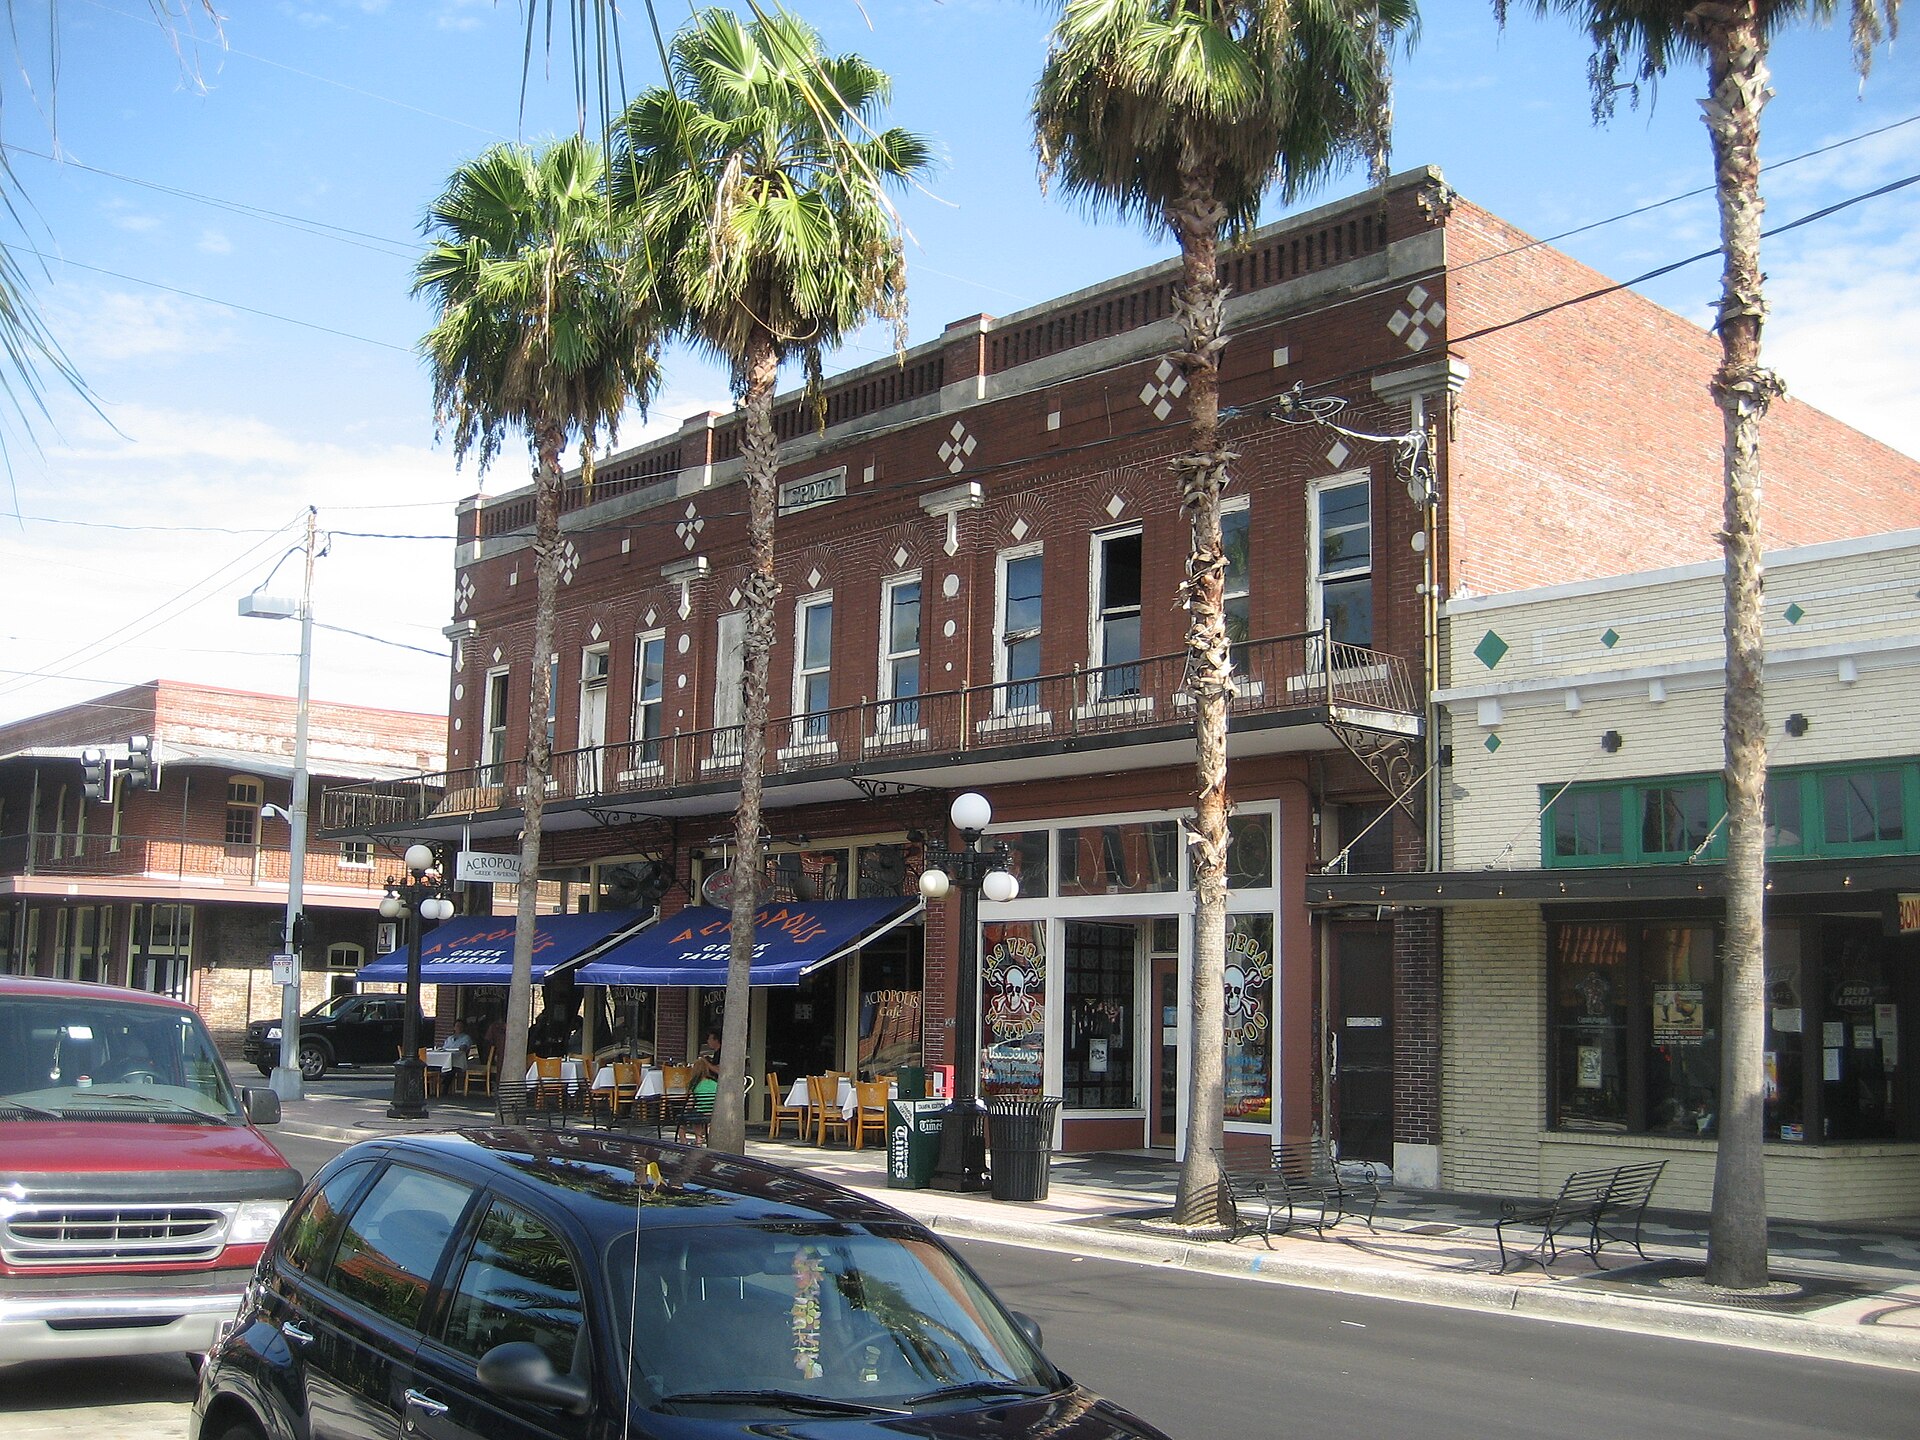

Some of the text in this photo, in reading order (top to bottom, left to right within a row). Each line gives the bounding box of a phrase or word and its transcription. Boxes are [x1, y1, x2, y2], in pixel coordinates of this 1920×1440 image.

[790, 479, 836, 504] SPOTO
[1067, 823, 1269, 882] TATTO
[465, 857, 521, 873] ACROPOLI
[474, 869, 517, 878] GREEK TAVERNA
[1899, 900, 1920, 929] BON
[450, 949, 507, 957] GREEK
[702, 943, 772, 952] GRK
[678, 952, 765, 961] TAVEA
[982, 937, 1046, 981] LAS VEGAS
[285, 966, 290, 974] 8
[1842, 986, 1871, 996] BUD
[865, 989, 919, 1009] ACROPOLIS
[1837, 996, 1875, 1006] LIGHT
[879, 1005, 903, 1019] Café
[985, 1008, 1042, 1040] TATTOO
[1224, 1011, 1269, 1047] TTOO
[919, 1119, 943, 1132] Times
[895, 1125, 908, 1179] Times
